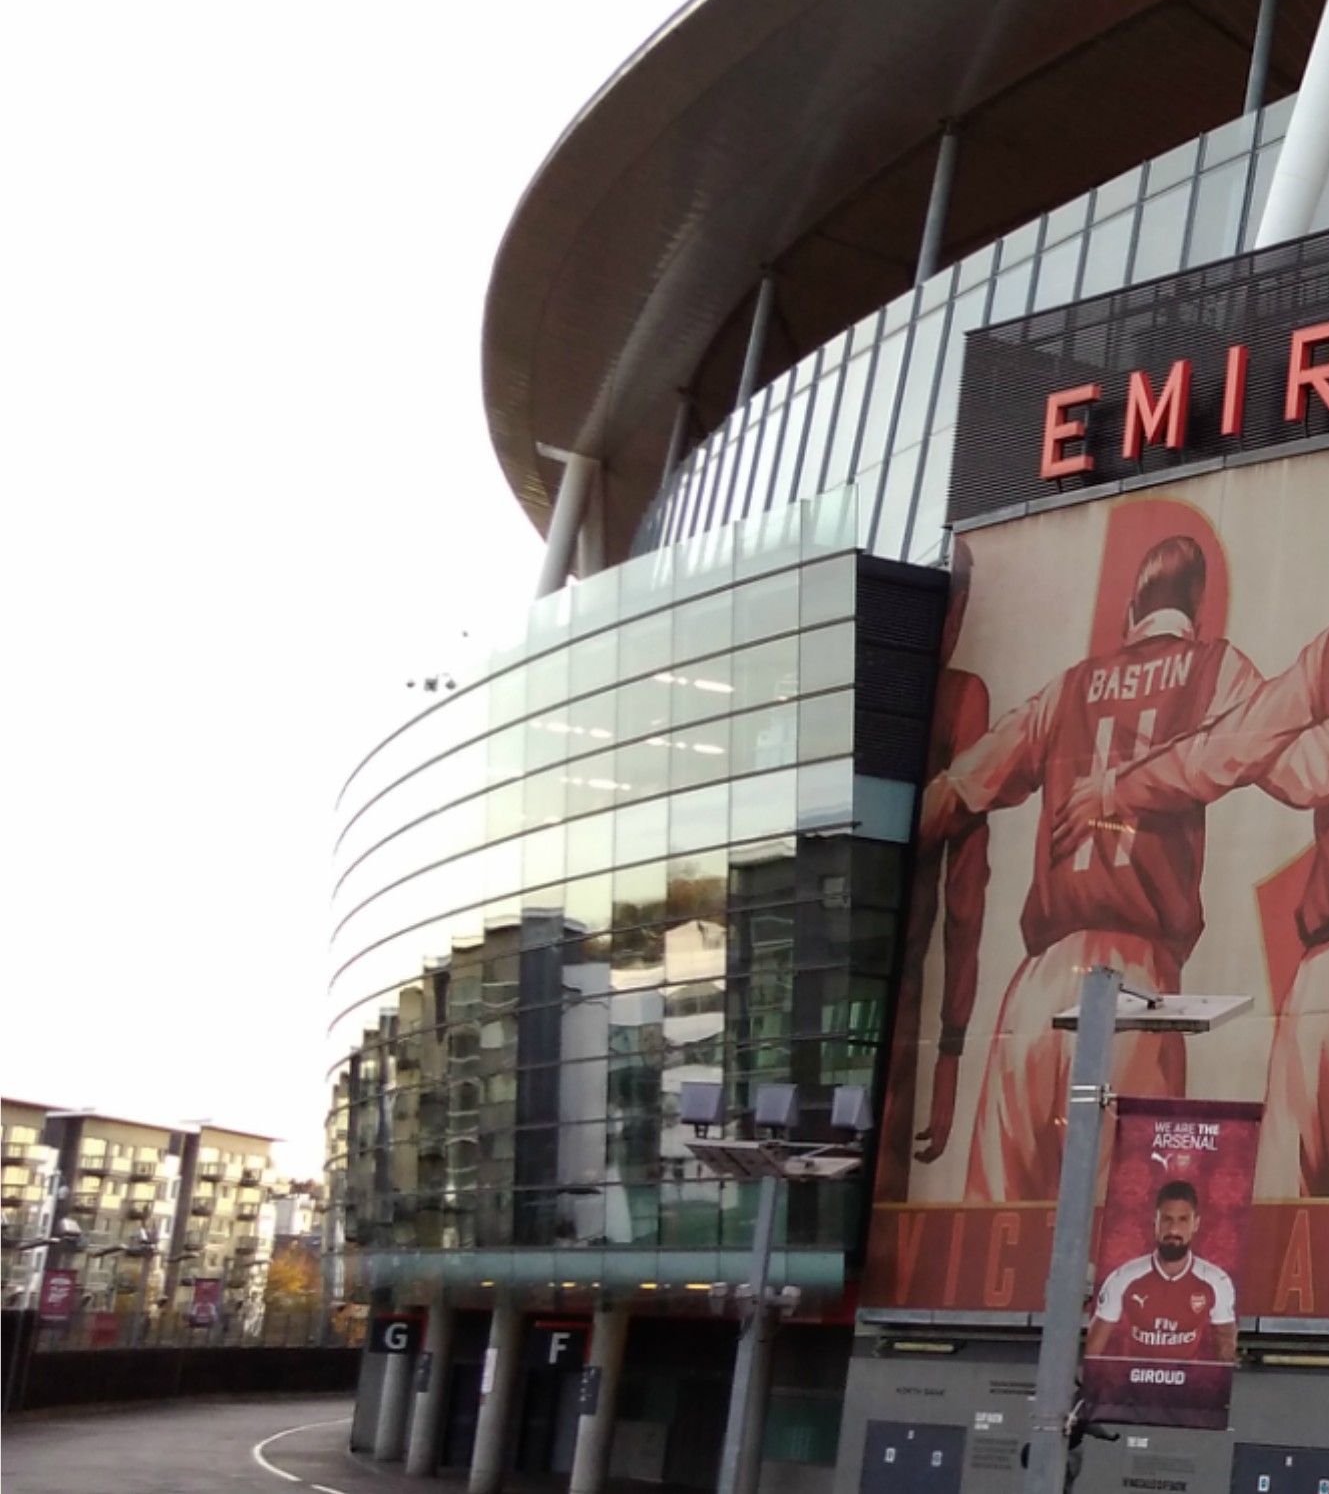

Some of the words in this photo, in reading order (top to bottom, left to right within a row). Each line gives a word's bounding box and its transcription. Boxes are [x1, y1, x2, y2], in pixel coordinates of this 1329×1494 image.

[1086, 651, 1194, 705] BASTIN
[1155, 1122, 1171, 1134] WE
[1175, 1123, 1195, 1134] ARE
[1198, 1123, 1220, 1135] THE
[1152, 1134, 1218, 1151] ARSENAL
[1154, 1318, 1178, 1331] Fly
[384, 1322, 408, 1350] G
[549, 1332, 570, 1364] F
[1130, 1368, 1186, 1385] GIROUD
